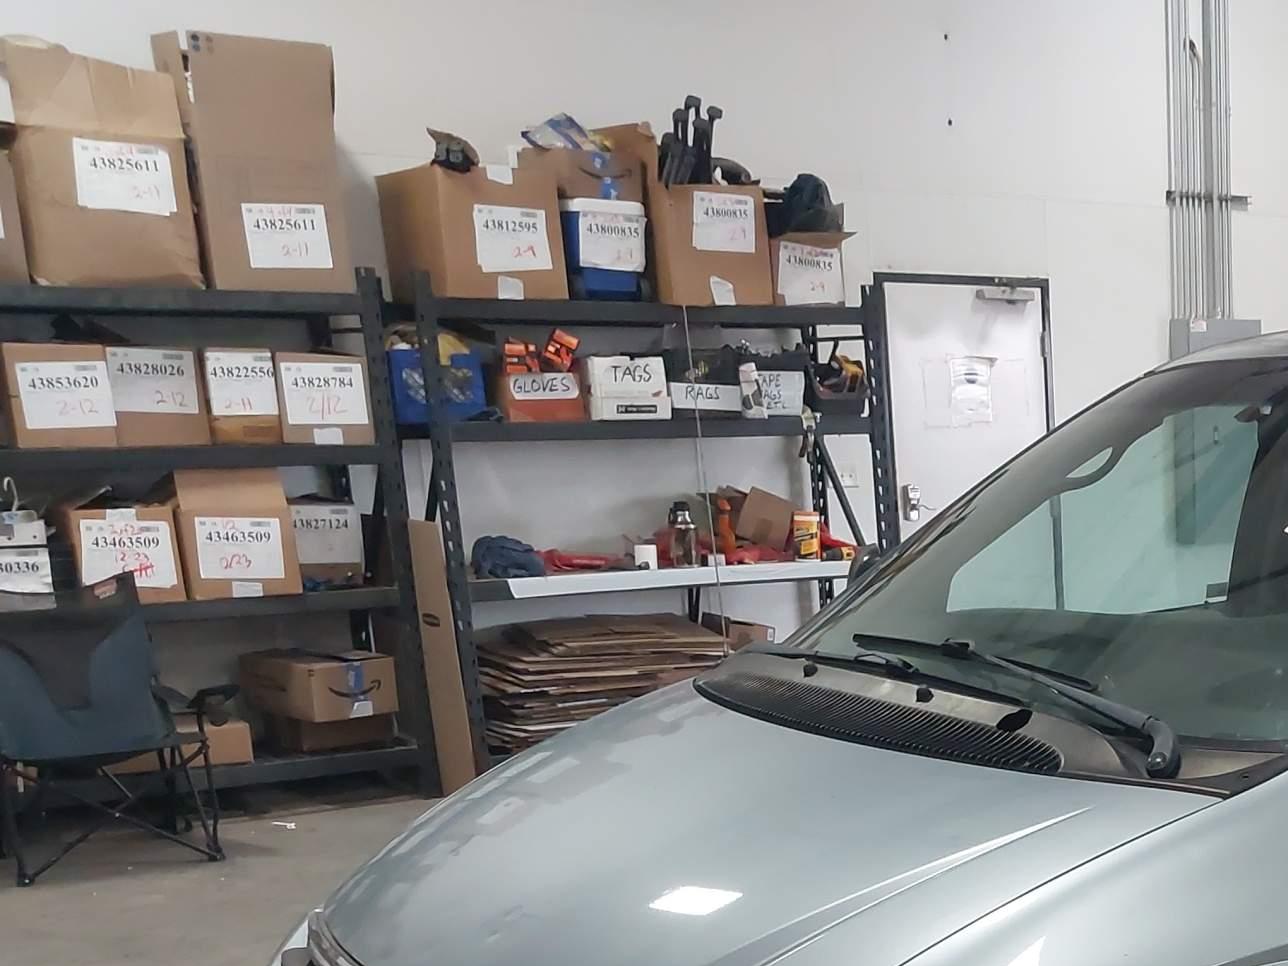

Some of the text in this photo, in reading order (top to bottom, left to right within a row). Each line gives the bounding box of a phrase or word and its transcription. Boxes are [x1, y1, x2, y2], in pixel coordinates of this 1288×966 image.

[90, 157, 159, 172] 43825611
[703, 207, 748, 219] 43800835
[253, 218, 316, 231] 43825611
[483, 219, 538, 234] 43812595
[586, 223, 640, 239] 43800835
[117, 362, 185, 377] 43828026
[210, 366, 274, 379] 43822556
[611, 364, 652, 383] TAGS
[28, 376, 99, 390] 43853620
[291, 377, 354, 388] 43828784
[513, 376, 570, 393] GLOVES
[685, 385, 719, 400] RAGS
[762, 390, 782, 400] AGS
[56, 399, 98, 417] 2-12
[91, 537, 160, 549] 43463509
[205, 531, 271, 542] 43463509
